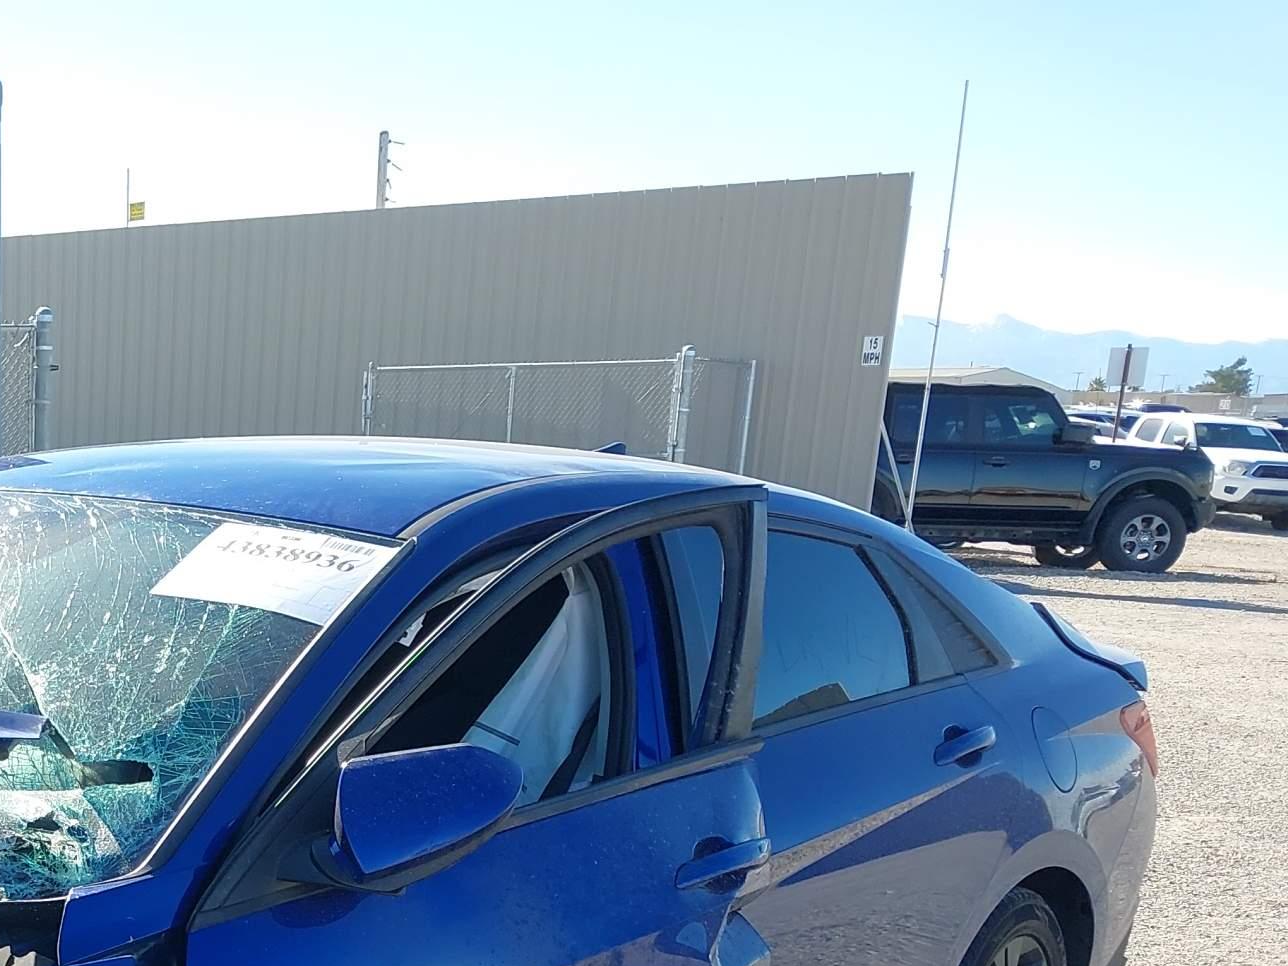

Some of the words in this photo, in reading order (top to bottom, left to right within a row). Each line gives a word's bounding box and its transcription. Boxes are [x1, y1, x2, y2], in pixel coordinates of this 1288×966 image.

[869, 337, 879, 350] 15
[862, 352, 881, 364] MPH
[216, 540, 361, 573] 43838936
